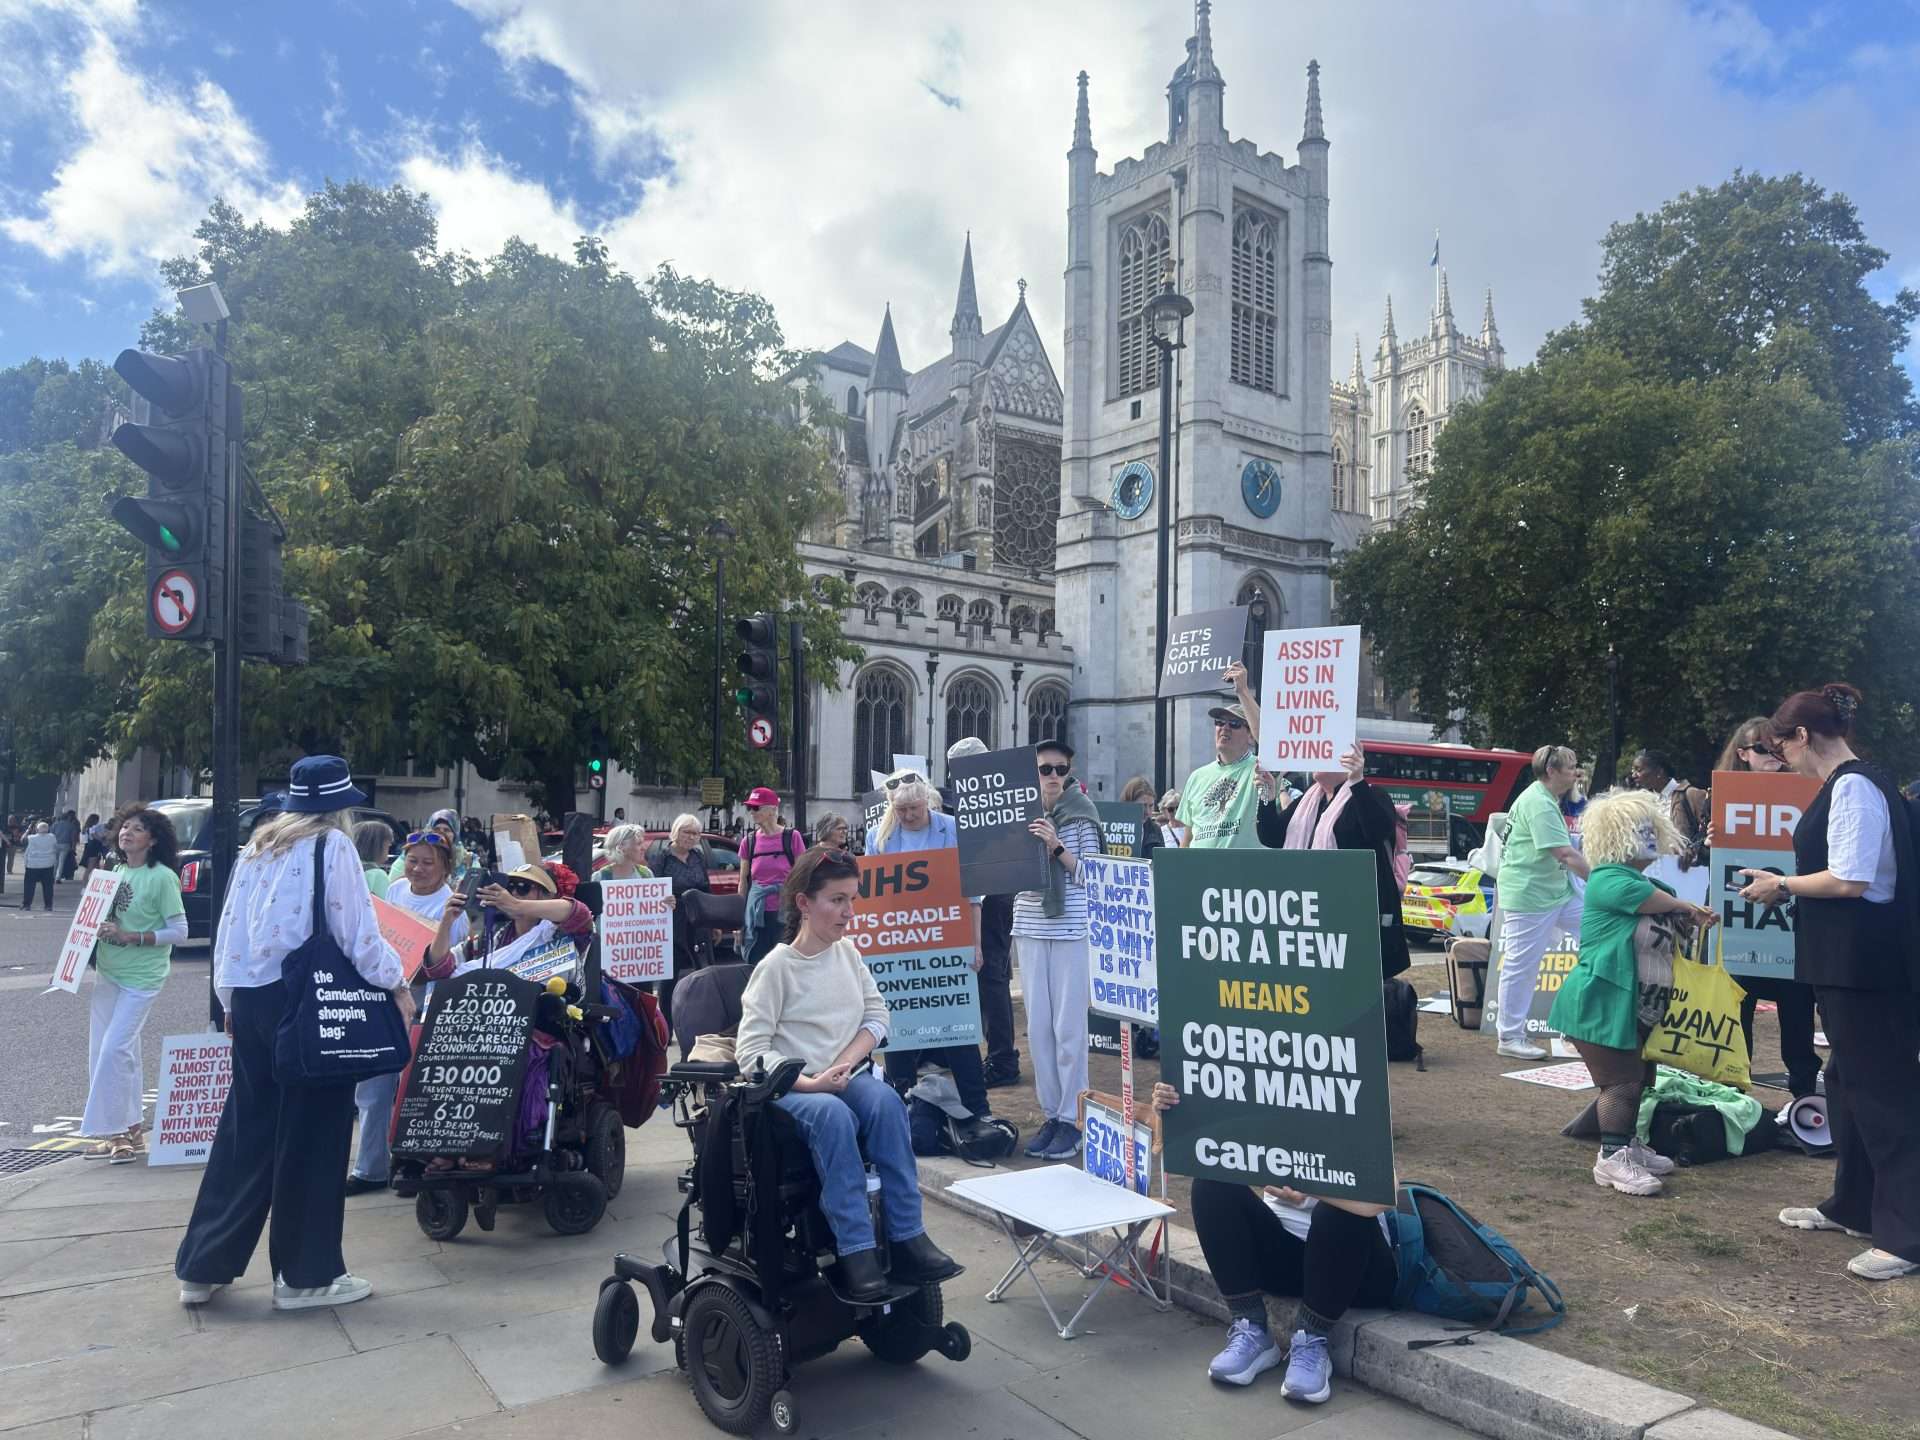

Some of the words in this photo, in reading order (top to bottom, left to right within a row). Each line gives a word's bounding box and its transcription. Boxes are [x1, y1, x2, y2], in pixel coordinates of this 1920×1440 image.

[1171, 627, 1213, 645] LET'S
[1168, 643, 1211, 661] CARE
[1277, 639, 1345, 661] ASSIST
[1166, 660, 1199, 677] NOT
[1200, 655, 1233, 672] KILL
[1284, 665, 1309, 685] US
[1315, 664, 1334, 684] IN
[1276, 690, 1340, 712] LIVING,
[1289, 715, 1326, 734] NOT
[1278, 740, 1334, 759] DYING
[955, 776, 979, 794] NO
[982, 773, 1006, 790] TO
[957, 787, 1038, 812] ASSISTED
[959, 807, 1027, 830] SUICIDE
[1110, 822, 1135, 833] OPEN
[1725, 803, 1802, 837] FIR
[1124, 834, 1135, 844] TO
[1083, 859, 1108, 883] MY
[1112, 864, 1150, 887] LIFE
[607, 884, 667, 900] PROTECT
[1086, 882, 1099, 900] IS
[1104, 885, 1134, 903] NOT
[1136, 889, 1149, 906] A
[76, 896, 104, 928] BILL
[606, 902, 634, 917] OUR
[639, 900, 667, 915] NHS
[882, 905, 962, 927] CRADLE
[1201, 887, 1320, 927] CHOICE
[1723, 900, 1794, 932] HA
[606, 929, 669, 946] NATIONAL
[877, 926, 944, 946] GRAVE
[1090, 921, 1114, 950] SO
[1117, 928, 1154, 962] WHY
[612, 945, 663, 962] SUICIDE
[1181, 925, 1241, 963] FOR
[1249, 929, 1271, 965] A
[1278, 930, 1348, 970] FEW
[61, 949, 80, 983] ILL
[611, 961, 664, 978] SERVICE
[929, 955, 967, 969] OLD,
[1100, 953, 1114, 973] IS
[1118, 957, 1141, 979] MY
[313, 970, 334, 984] the
[876, 973, 968, 993] ONVENIENT
[465, 982, 509, 998] R.I.P.
[1093, 978, 1158, 1015] DEATH?
[1219, 979, 1310, 1015] MEANS
[1671, 987, 1689, 1002] OU
[885, 992, 971, 1012] XPENSIVE!
[318, 1006, 367, 1022] shopping
[435, 1014, 482, 1025] EXCESS
[485, 1015, 529, 1027] DEATHS
[433, 1025, 455, 1034] DUE
[472, 1025, 511, 1034] HEALTH
[918, 1023, 940, 1035] duty
[952, 1023, 975, 1032] care
[1661, 1008, 1740, 1046] WANT
[431, 1034, 466, 1044] SOCIAL
[1088, 1033, 1102, 1048] re
[1182, 1021, 1357, 1074] COERCION
[199, 1046, 233, 1059] DOCT
[1121, 1028, 1130, 1071] FRAGILE
[169, 1060, 216, 1075] ALMOST
[218, 1060, 233, 1072] CU
[175, 1074, 215, 1088] SHORT
[215, 1073, 233, 1086] MY
[1182, 1060, 1247, 1102] FOR
[1254, 1068, 1362, 1116] MANY
[169, 1088, 209, 1102] MUM'S
[212, 1087, 229, 1100] LIF
[477, 1087, 513, 1098] DEATHS!
[168, 1104, 185, 1116] BY
[186, 1103, 193, 1115] 3
[197, 1101, 225, 1114] YEAR
[434, 1102, 475, 1121] 6:10
[1123, 1083, 1133, 1126] FRAGILE
[161, 1117, 191, 1131] WITH
[194, 1116, 221, 1129] WRO
[406, 1128, 432, 1138] BEING
[409, 1118, 442, 1129] COVID
[444, 1120, 480, 1131] DEATHS
[160, 1130, 216, 1145] PROGNOS
[185, 1149, 206, 1157] BRIAN
[1126, 1136, 1135, 1180] FRAGILE
[1195, 1137, 1293, 1177] care
[1292, 1150, 1326, 1167] NOT
[1086, 1142, 1147, 1197] BURDN
[1293, 1165, 1357, 1187] KILLING
